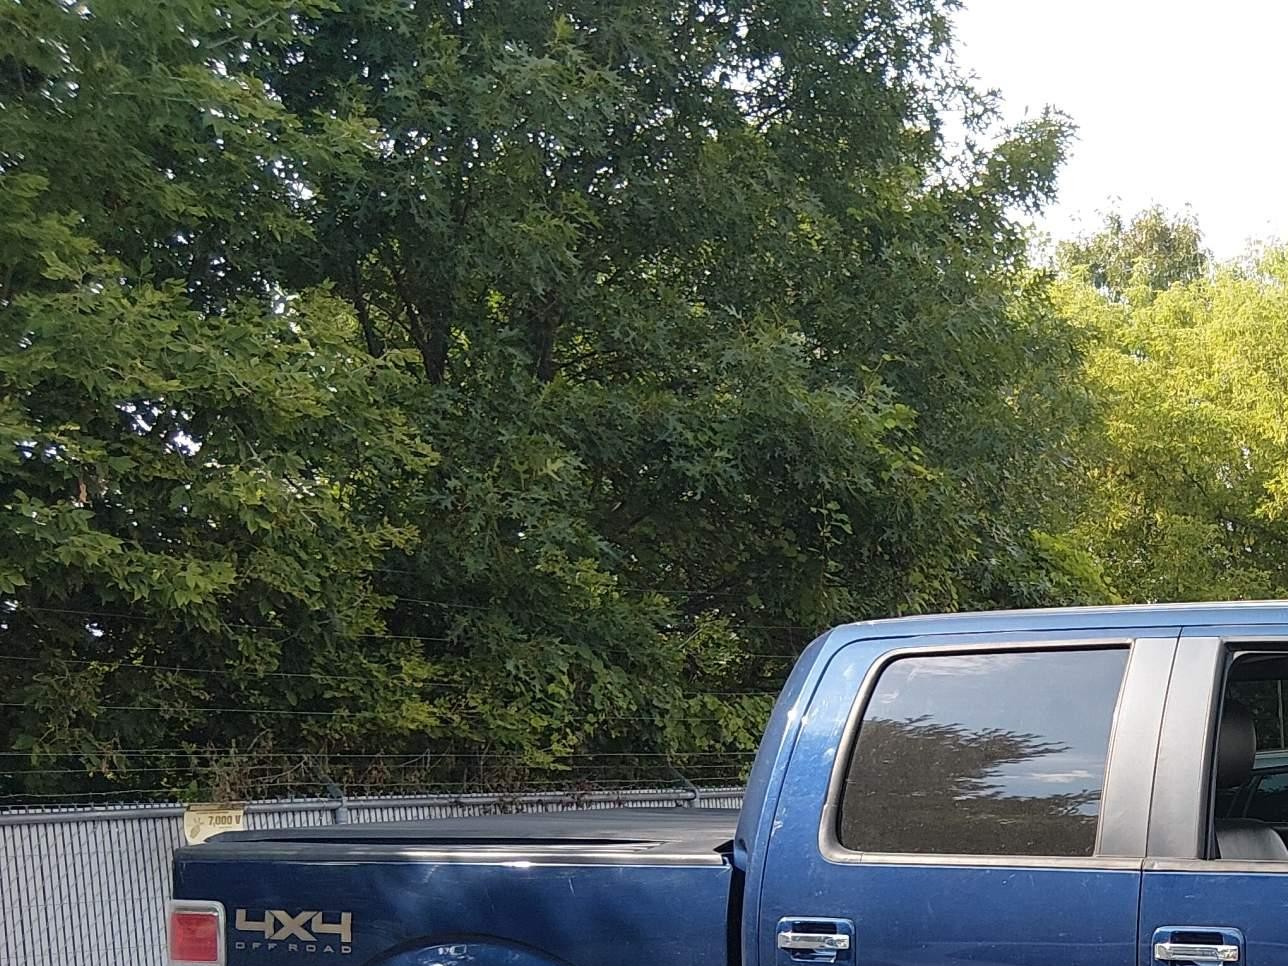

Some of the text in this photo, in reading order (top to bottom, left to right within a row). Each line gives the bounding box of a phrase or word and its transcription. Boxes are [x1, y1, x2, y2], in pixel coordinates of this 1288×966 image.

[208, 815, 233, 827] 7,000
[235, 942, 352, 954] OFF ROAD
